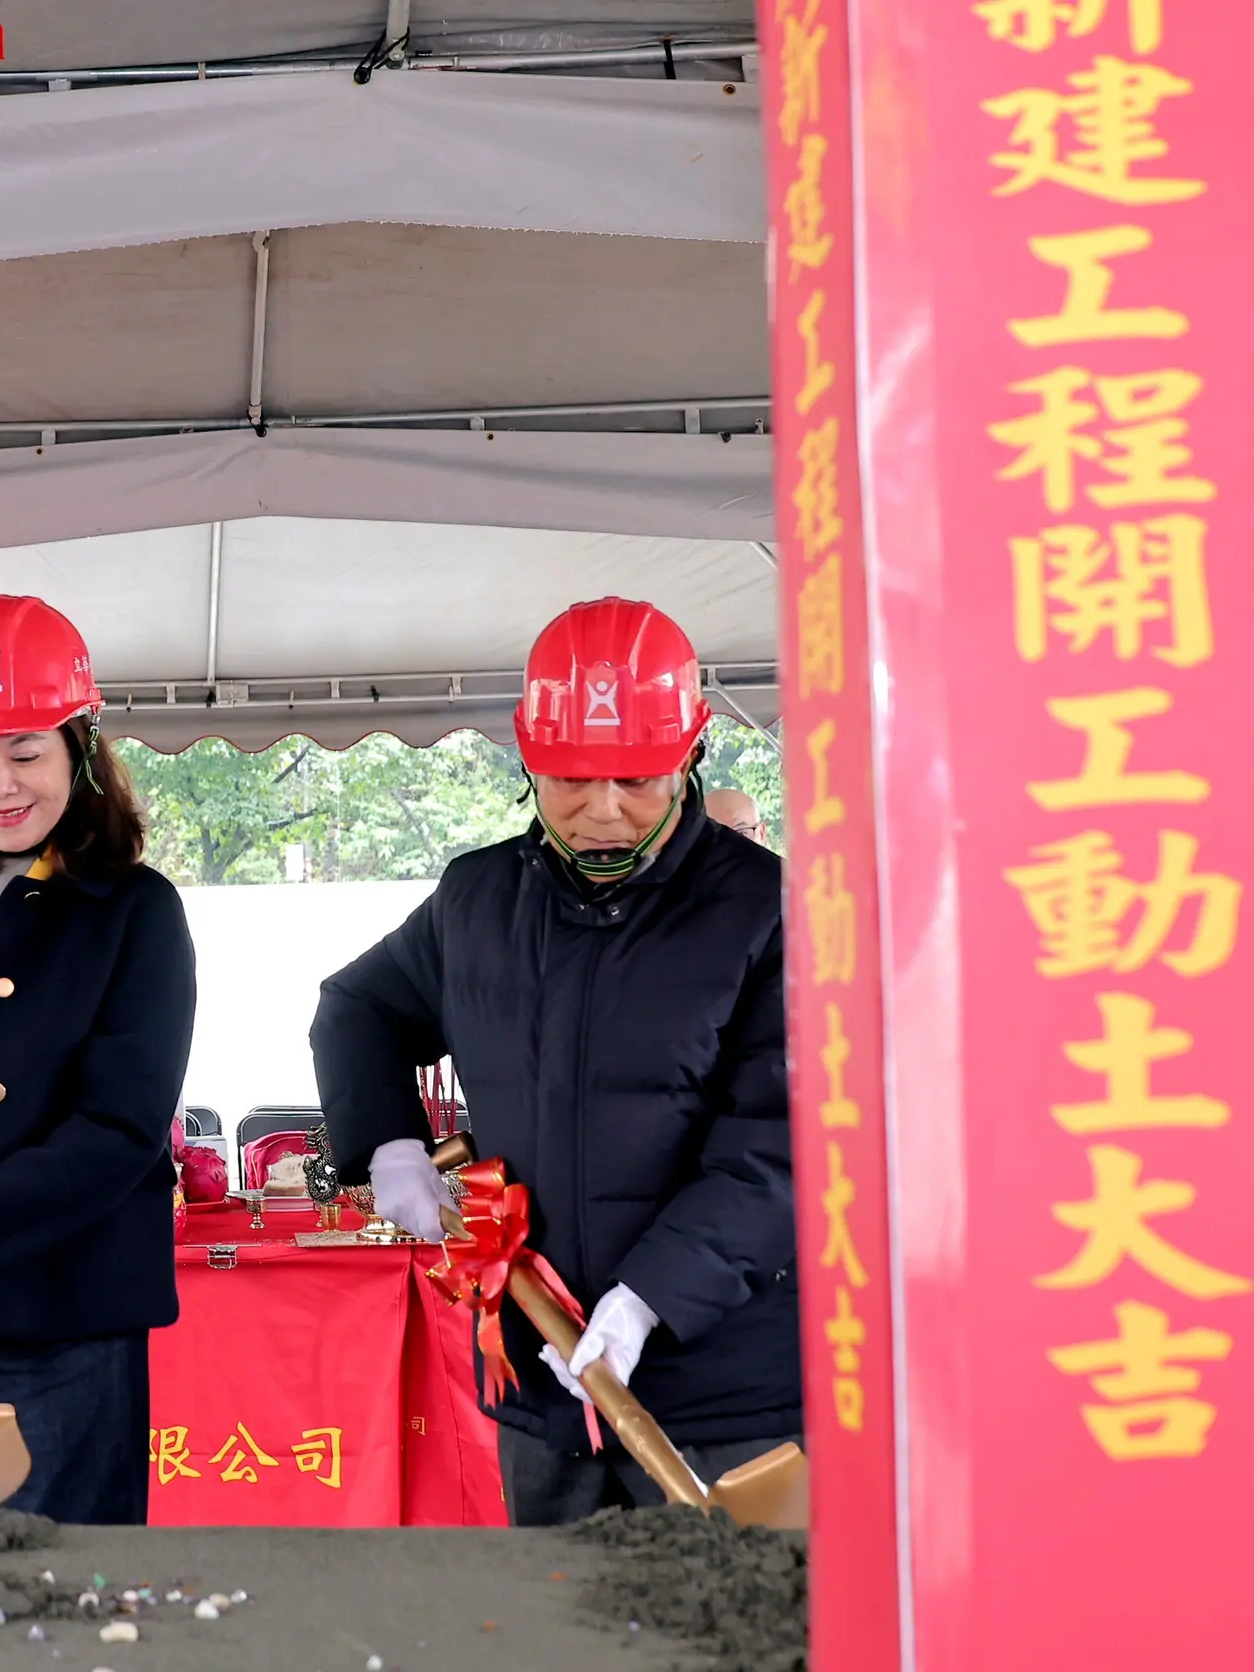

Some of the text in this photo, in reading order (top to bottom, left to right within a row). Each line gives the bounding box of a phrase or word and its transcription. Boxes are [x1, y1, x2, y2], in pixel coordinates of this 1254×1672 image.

[774, 0, 869, 1432] 新建工程開工動土大吉
